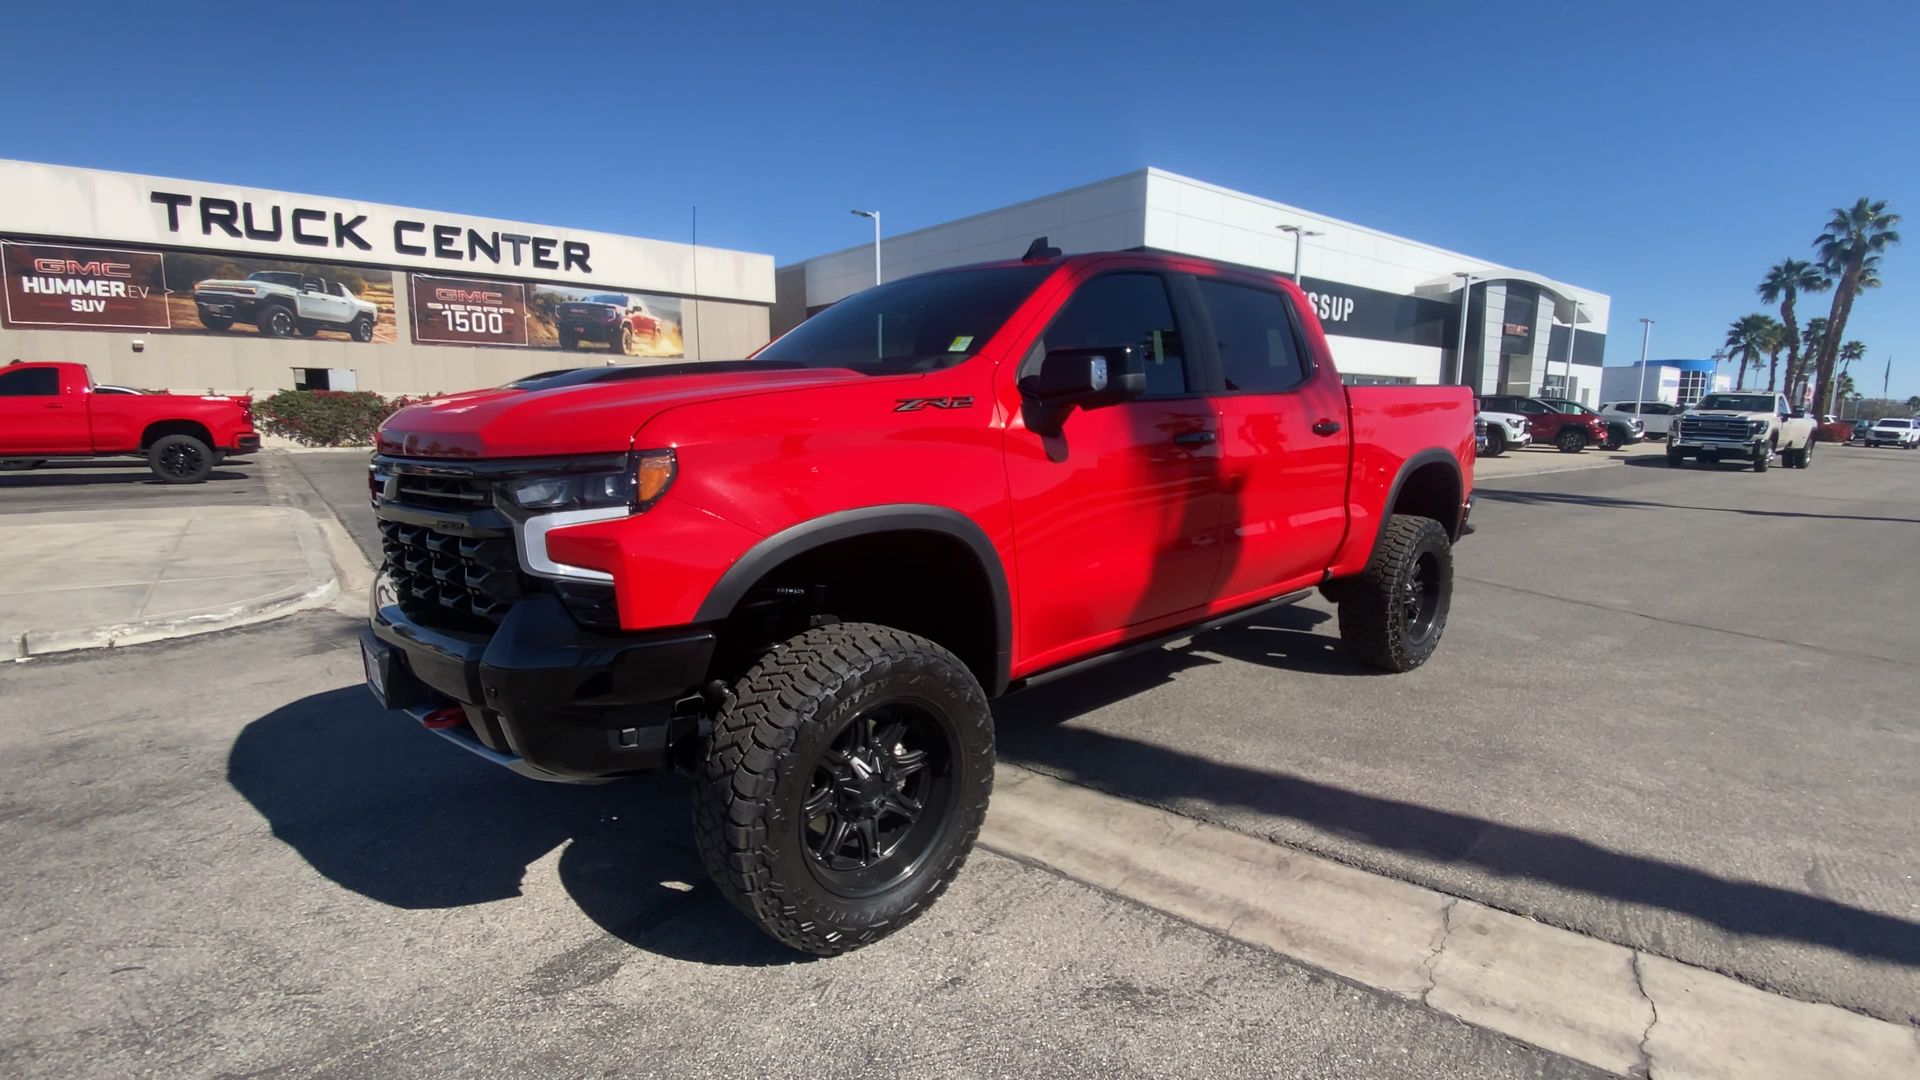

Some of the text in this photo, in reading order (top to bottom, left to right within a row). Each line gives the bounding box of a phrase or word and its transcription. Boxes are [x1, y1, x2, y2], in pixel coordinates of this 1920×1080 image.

[150, 191, 593, 273] TRUCK CENTER
[34, 258, 132, 278] GMC
[22, 276, 149, 299] HUMMER EV
[435, 288, 503, 305] GMC
[71, 299, 106, 313] SUV
[1303, 291, 1354, 322] SSUP
[441, 310, 503, 334] 1500
[893, 395, 974, 413] ZR2
